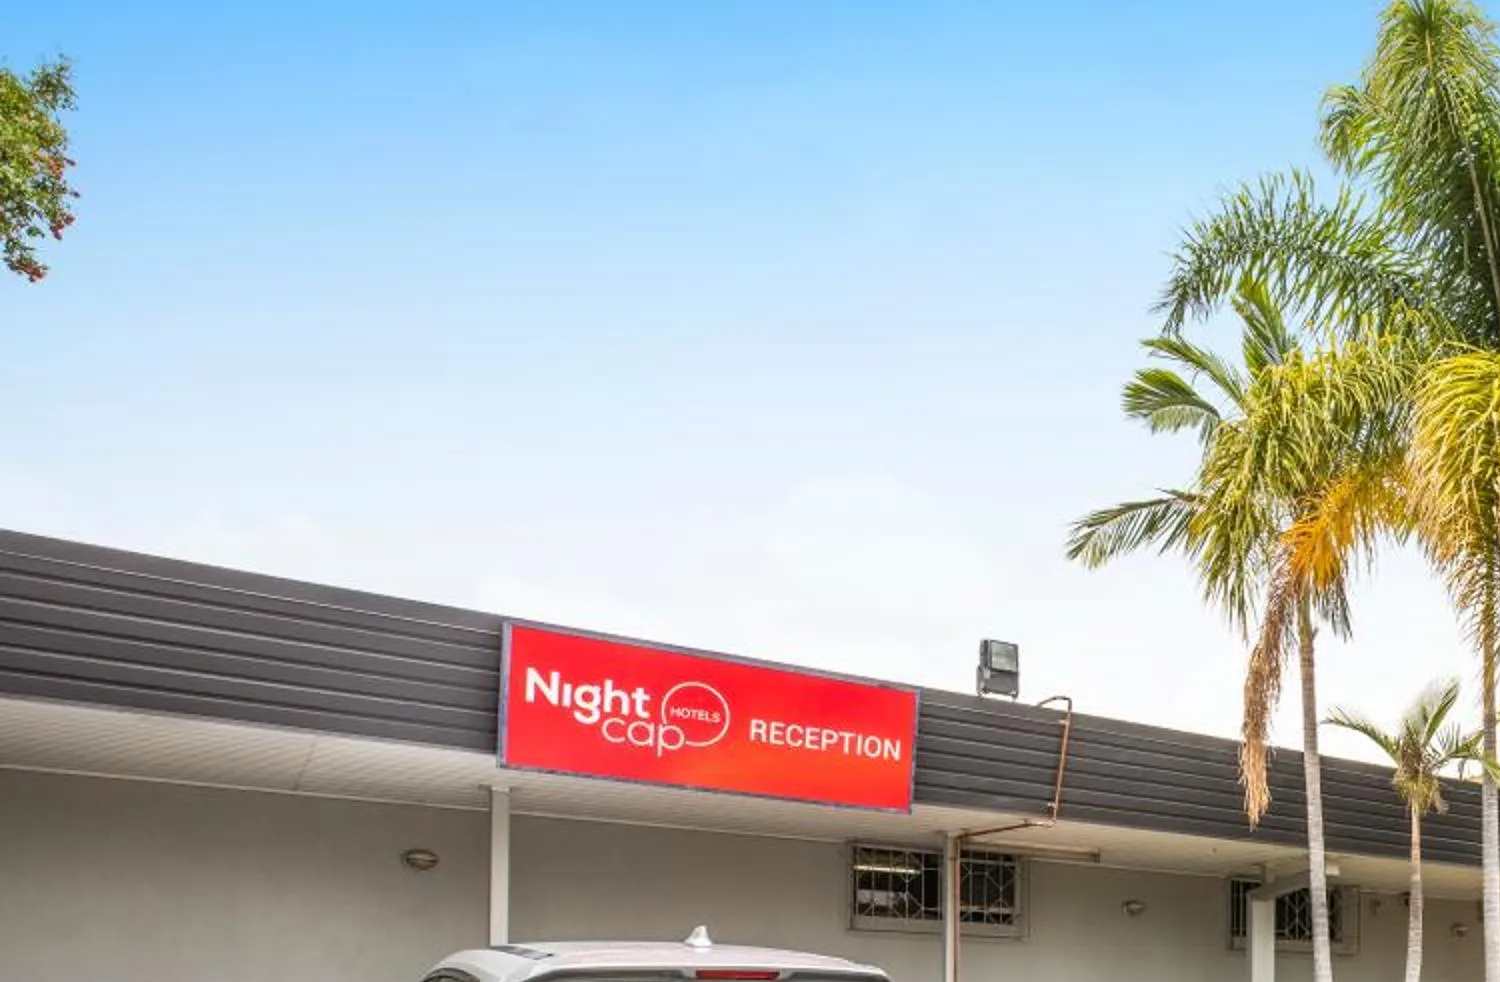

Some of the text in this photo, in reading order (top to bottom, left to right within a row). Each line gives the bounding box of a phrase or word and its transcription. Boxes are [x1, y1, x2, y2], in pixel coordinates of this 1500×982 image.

[525, 667, 650, 724] Night
[670, 707, 720, 723] HOTELS
[601, 718, 685, 757] cap
[750, 719, 901, 761] RECEPTION
